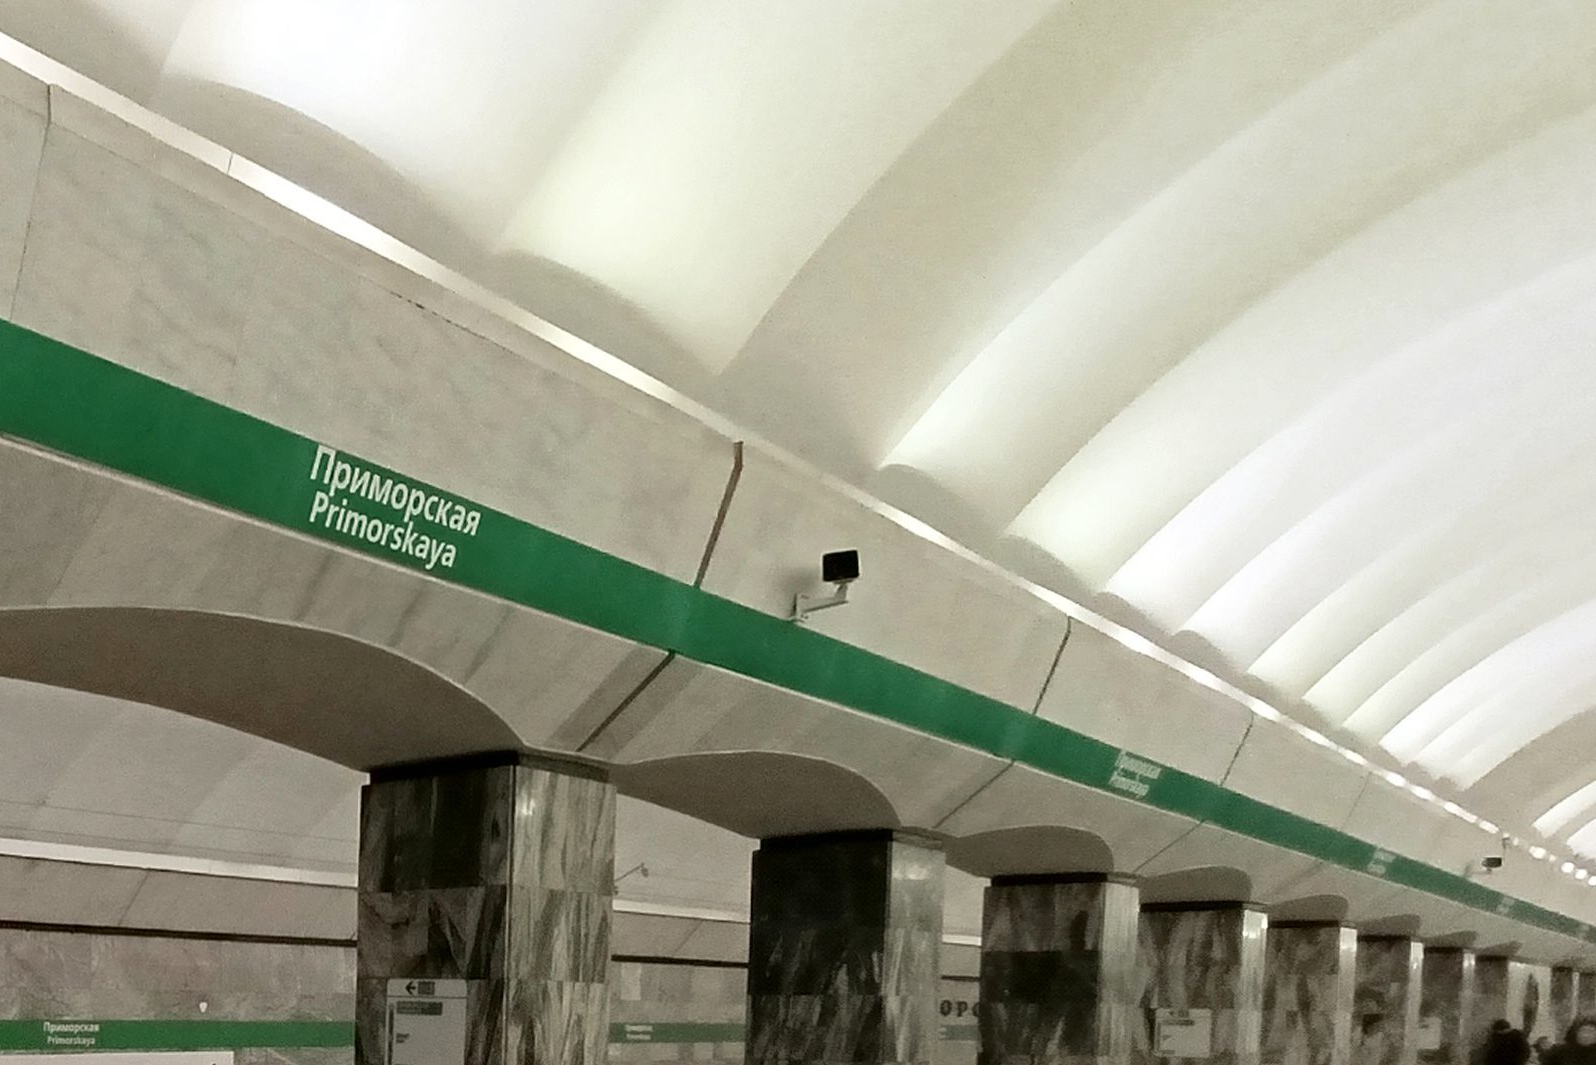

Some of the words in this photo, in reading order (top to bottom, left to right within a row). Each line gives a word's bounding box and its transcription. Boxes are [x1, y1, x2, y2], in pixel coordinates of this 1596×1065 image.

[310, 444, 481, 536] Приморская
[309, 491, 456, 570] Primorskaya
[43, 1021, 99, 1034] Приморская
[47, 1035, 95, 1047] Primorskaya
